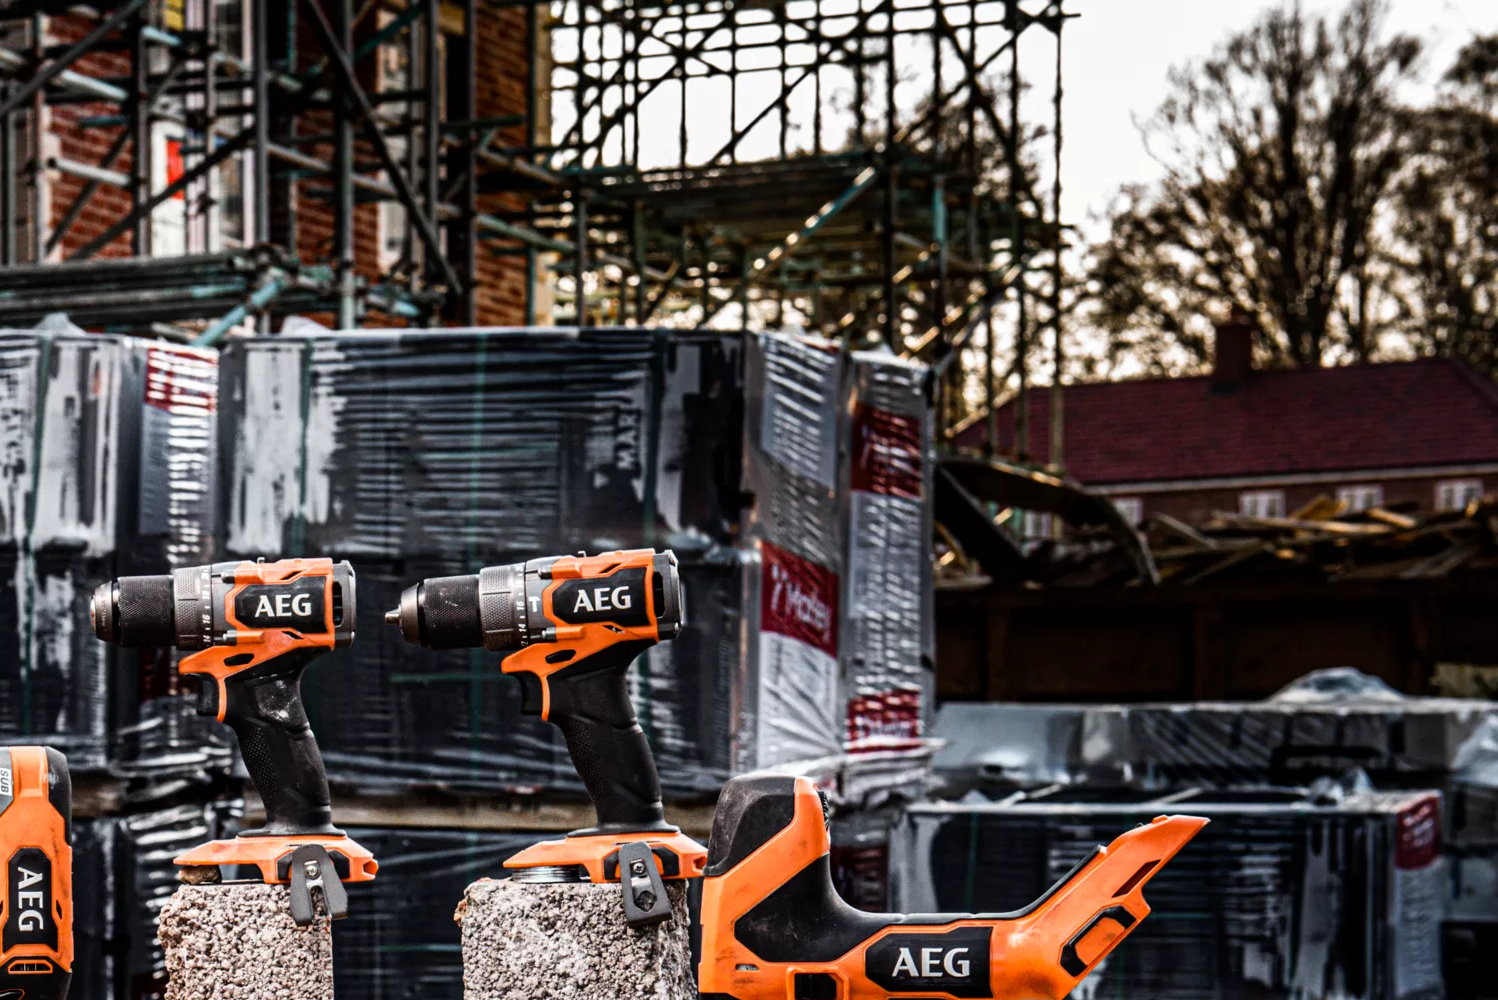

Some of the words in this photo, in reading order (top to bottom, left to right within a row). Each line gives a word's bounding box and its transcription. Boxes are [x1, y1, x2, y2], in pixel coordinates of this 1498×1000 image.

[254, 593, 312, 618] AEG
[573, 585, 632, 613] AEG
[0, 769, 9, 793] SUB
[17, 866, 44, 932] AEG
[891, 947, 970, 978] AEG
